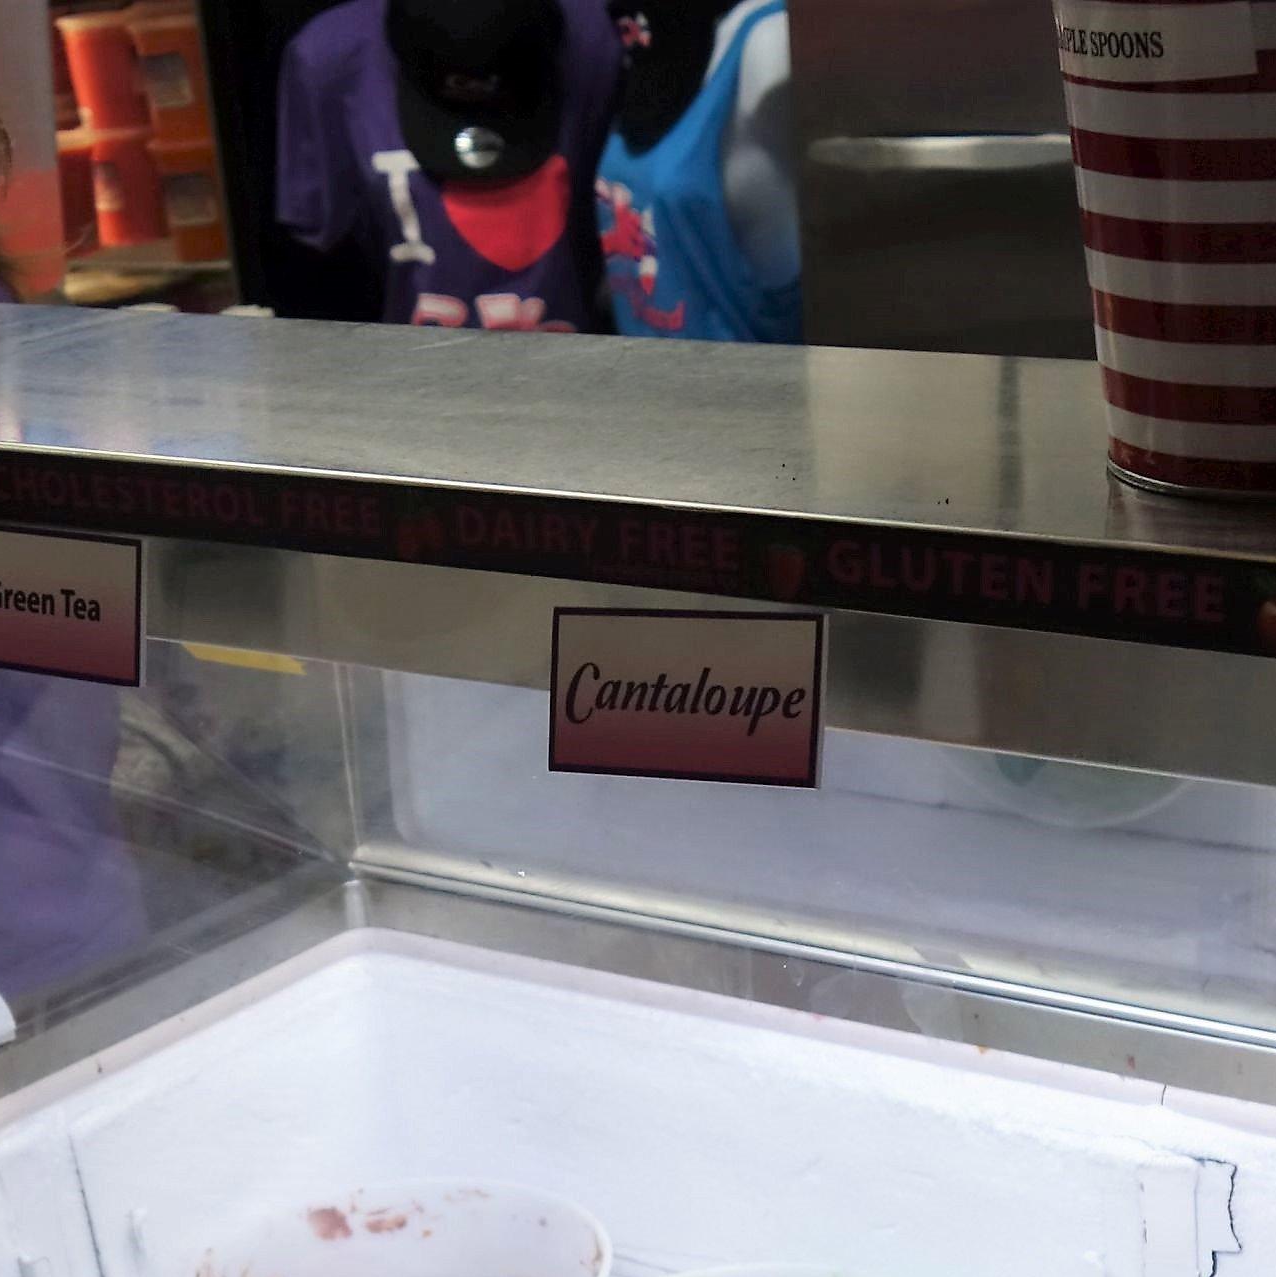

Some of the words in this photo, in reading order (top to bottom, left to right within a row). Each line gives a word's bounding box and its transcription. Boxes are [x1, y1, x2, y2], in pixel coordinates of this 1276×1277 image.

[1090, 31, 1164, 59] SPOONS
[280, 490, 382, 537] FREE
[455, 504, 600, 555] DAIRY
[618, 522, 741, 569] FREE
[61, 589, 101, 622] Tea
[826, 537, 1054, 604] GLUTEN
[1076, 560, 1229, 624] FREE
[565, 661, 807, 737] Cantaloupe
